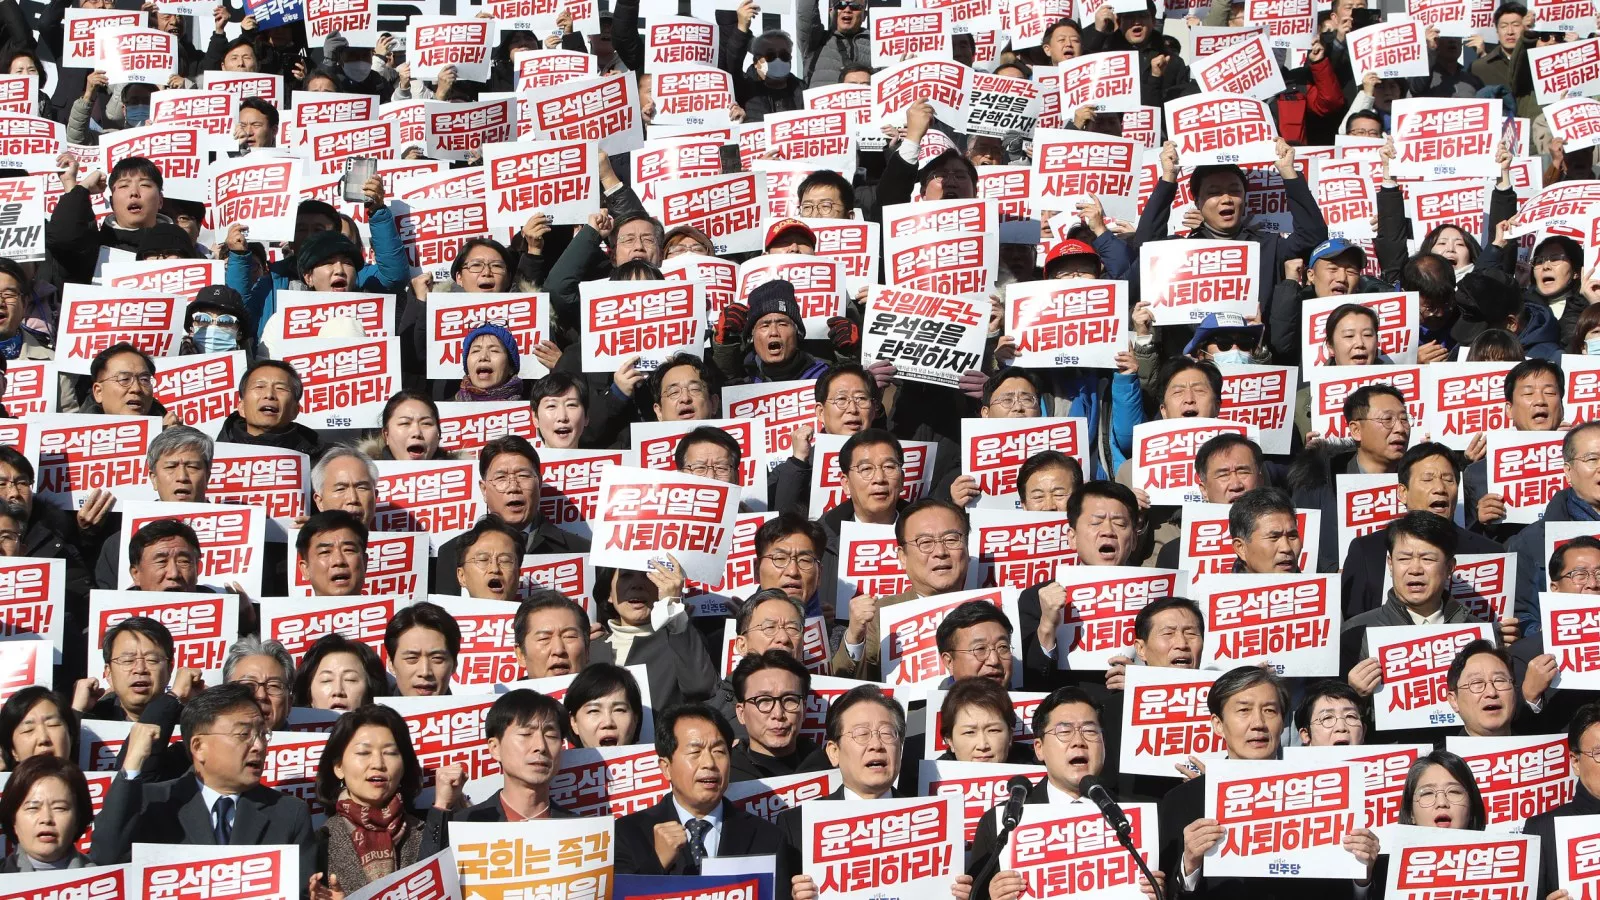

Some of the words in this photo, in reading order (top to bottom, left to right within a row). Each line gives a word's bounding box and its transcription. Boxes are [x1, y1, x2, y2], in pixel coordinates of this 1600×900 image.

[491, 1, 557, 19] 사퇴하라!
[879, 15, 939, 35] 윤석열은
[1538, 1, 1597, 22] 사퇴하라!
[113, 34, 168, 52] 석열은
[420, 26, 484, 45] 윤석열은
[655, 24, 710, 43] 윤석열은
[880, 35, 944, 57] 사퇴하라!
[418, 46, 486, 67] 사퇴하라!
[523, 56, 585, 76] 윤석열은
[654, 45, 713, 63] 사퇴하라!
[1206, 42, 1264, 88] 윤석열은
[1539, 44, 1598, 77] 윤석열은
[661, 72, 724, 93] 윤석열은
[882, 62, 959, 90] 윤석열은
[157, 99, 227, 120] 윤석열은
[302, 102, 367, 123] 윤석열은
[543, 82, 623, 122] 윤석열은
[660, 93, 731, 114] 사퇴하라!
[881, 86, 962, 117] 사퇴하라!
[1178, 102, 1261, 131] 윤석열은
[1558, 104, 1600, 126] 윤석열
[435, 105, 504, 132] 윤석열은
[773, 115, 843, 139] 윤석열은
[968, 108, 1036, 132] 탄핵하자!
[1403, 105, 1484, 135] 윤석열은
[318, 128, 388, 155] 윤석열은
[437, 126, 510, 152] 사퇴하라!
[777, 140, 849, 161] 사퇴하라!
[1182, 127, 1272, 154] 사퇴하라!
[1402, 134, 1493, 162] 사퇴하라!
[496, 148, 581, 182] 윤석열은
[1045, 147, 1128, 170] 윤석열은
[1216, 153, 1239, 162] 민주당
[1434, 166, 1456, 175] 민주당
[217, 166, 288, 198] 윤석열은
[1042, 171, 1132, 196] 사퇴하라!
[219, 194, 288, 228] 사퇴하라!
[498, 182, 591, 214] 사퇴하라!
[668, 179, 751, 221] 윤석열은
[402, 208, 484, 239] 윤석열은
[699, 206, 761, 238] 퇴하라!
[714, 244, 727, 252] 주당
[897, 239, 979, 277] 윤석열은
[1178, 248, 1242, 275] 석열은
[435, 270, 450, 279] 민주
[595, 289, 687, 326] 윤석열은
[873, 289, 982, 326] 친일매국노
[1019, 287, 1110, 323] 윤석열은
[1153, 278, 1249, 308] 사퇴하라!
[73, 302, 167, 329] 윤석열은
[869, 313, 965, 346] 윤석열을
[595, 320, 697, 358] 사퇴하라!
[1018, 318, 1119, 353] 사퇴하라!
[302, 346, 387, 383] 윤석열은
[634, 358, 658, 369] 민주당
[877, 341, 980, 373] 탄핵하자!
[1055, 356, 1079, 364] 민주당
[156, 360, 227, 400] 석열은
[1221, 373, 1281, 401] 석열은
[1444, 370, 1504, 409] 윤석열
[326, 417, 352, 428] 민주당
[440, 410, 530, 447] 윤석열은
[1443, 409, 1513, 435] 사퇴하
[42, 425, 140, 462] 윤석열은
[977, 426, 1072, 465] 윤석열은
[39, 460, 148, 493] 사퇴하라!
[208, 460, 297, 490] 윤석열은
[1499, 445, 1563, 481] 윤석열
[374, 470, 465, 505] 윤석열은
[609, 487, 719, 515] 윤석열은
[1503, 478, 1570, 507] 사퇴하
[606, 524, 723, 554] 사퇴하라!
[701, 603, 728, 613] 민주당
[1214, 583, 1319, 625] 윤석열은
[278, 605, 387, 651] 윤석열은
[458, 619, 516, 651] 윤석열
[1215, 619, 1329, 661] 사퇴하라!
[450, 655, 527, 685] 사퇴하
[1139, 687, 1213, 723] 윤석열
[1430, 713, 1455, 723] 민주당
[1134, 727, 1227, 756] 사퇴하
[1472, 744, 1565, 785] 윤석열은
[550, 761, 660, 805] 윤석열은
[1225, 774, 1341, 818] 윤석열은
[820, 810, 938, 853] 윤석열은
[1016, 814, 1133, 863] 윤석열은
[1221, 814, 1355, 857] 사퇴하라!
[458, 839, 550, 880] 국회는
[559, 832, 610, 864] 즉각
[820, 846, 951, 895] 사퇴하라!
[1269, 863, 1301, 874] 민주당
[1406, 846, 1519, 883] 윤석열은
[149, 858, 272, 900] 윤석열은
[1020, 853, 1148, 900] 사퇴하라!
